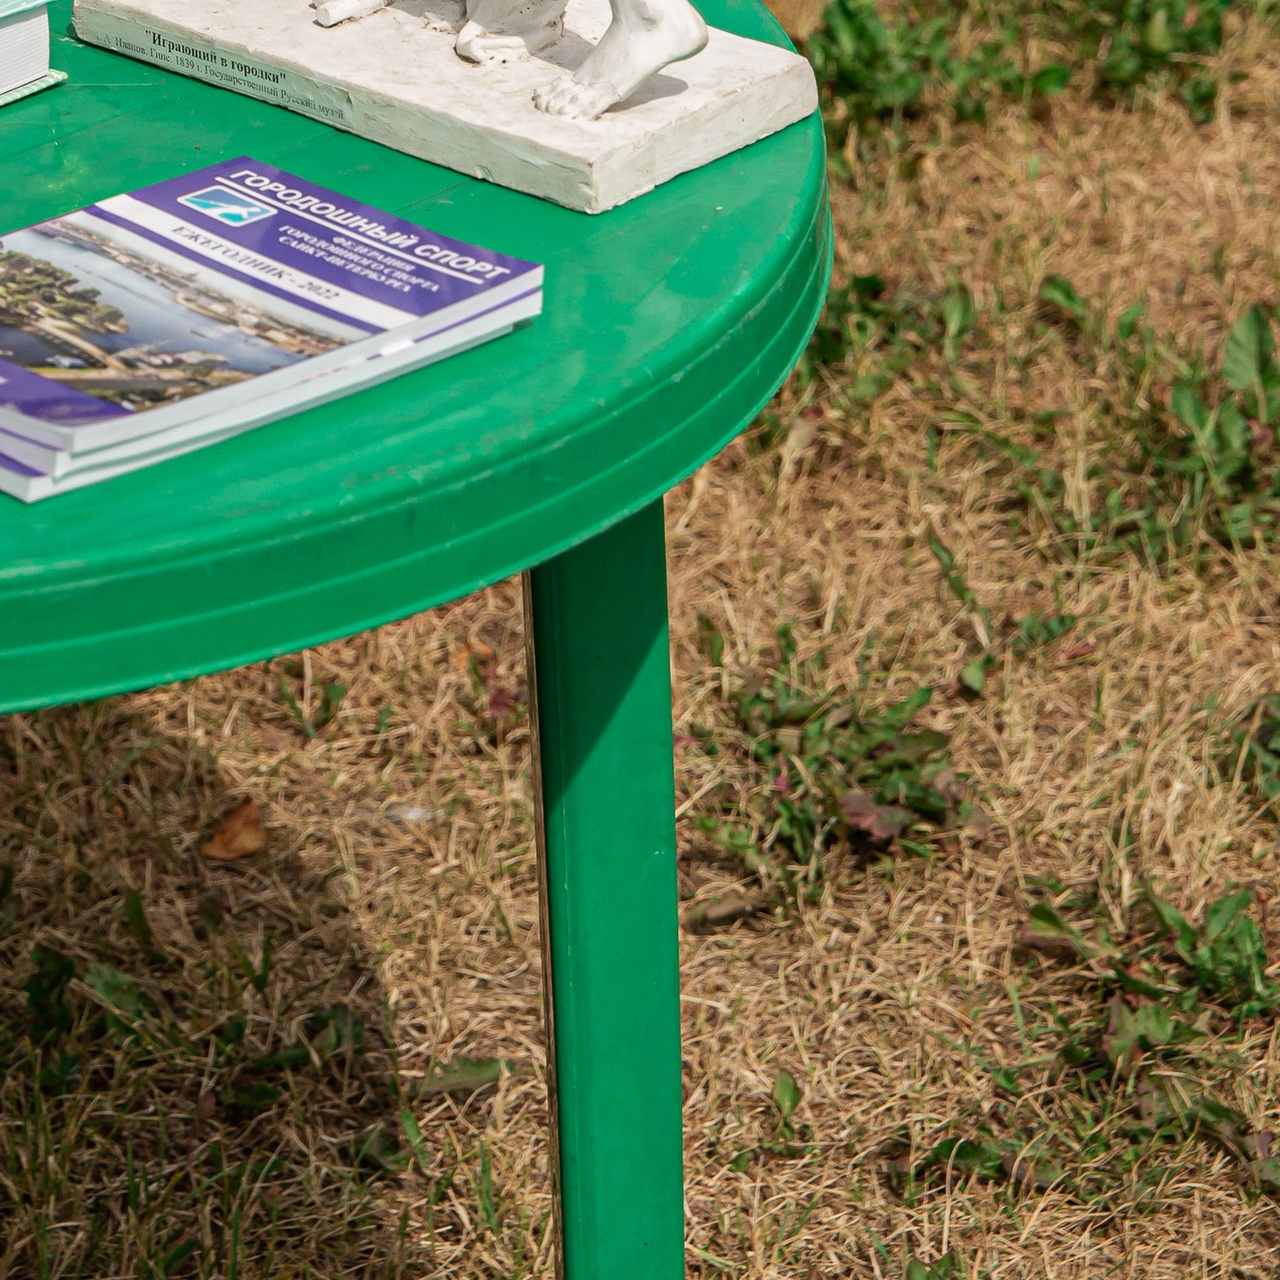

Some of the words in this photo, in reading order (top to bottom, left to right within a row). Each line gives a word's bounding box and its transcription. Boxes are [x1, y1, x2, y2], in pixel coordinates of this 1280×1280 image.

[145, 30, 218, 64] "Играющий
[220, 57, 228, 67] в
[231, 61, 287, 84] городки"
[150, 48, 173, 64] Гипс.
[175, 55, 195, 70] 1839
[205, 65, 279, 98] Государственный
[230, 169, 420, 249] ГОРОДОШНЫЙ
[413, 244, 513, 280] СПОРТ
[171, 225, 288, 280] ЕЖЕГОДНИК
[297, 280, 341, 301] 2022
[278, 224, 388, 276] ГОРОДОШНОГО
[383, 264, 441, 294] СПОРТА
[278, 236, 412, 294] САНКТ-ПЕТЕРБУРГА
[332, 236, 416, 273] ФЕДЕРАЦИЯ
